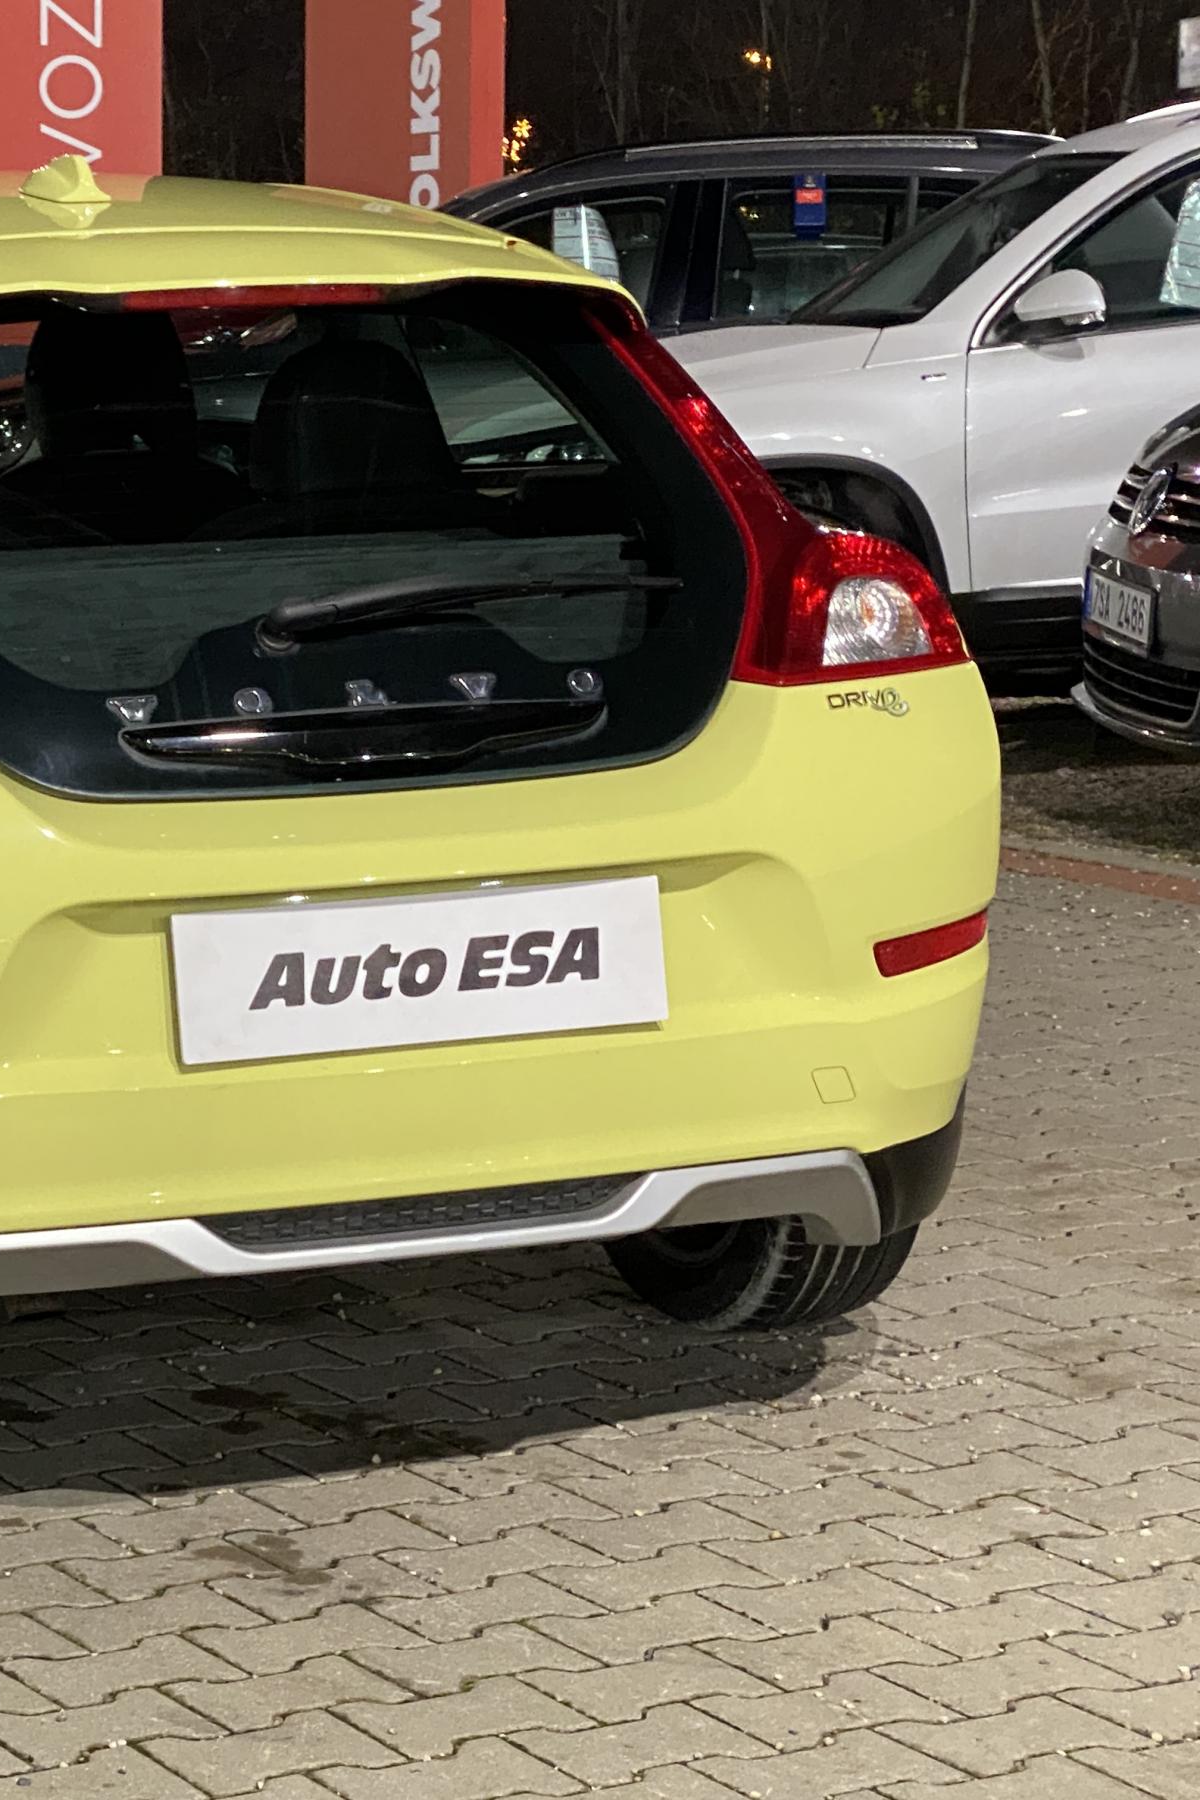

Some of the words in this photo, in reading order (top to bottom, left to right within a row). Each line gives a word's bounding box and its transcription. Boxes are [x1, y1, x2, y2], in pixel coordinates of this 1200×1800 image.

[1092, 578, 1110, 620] 7SA
[1117, 589, 1146, 634] 2486
[249, 943, 447, 1011] Auto
[458, 927, 601, 993] ESA
